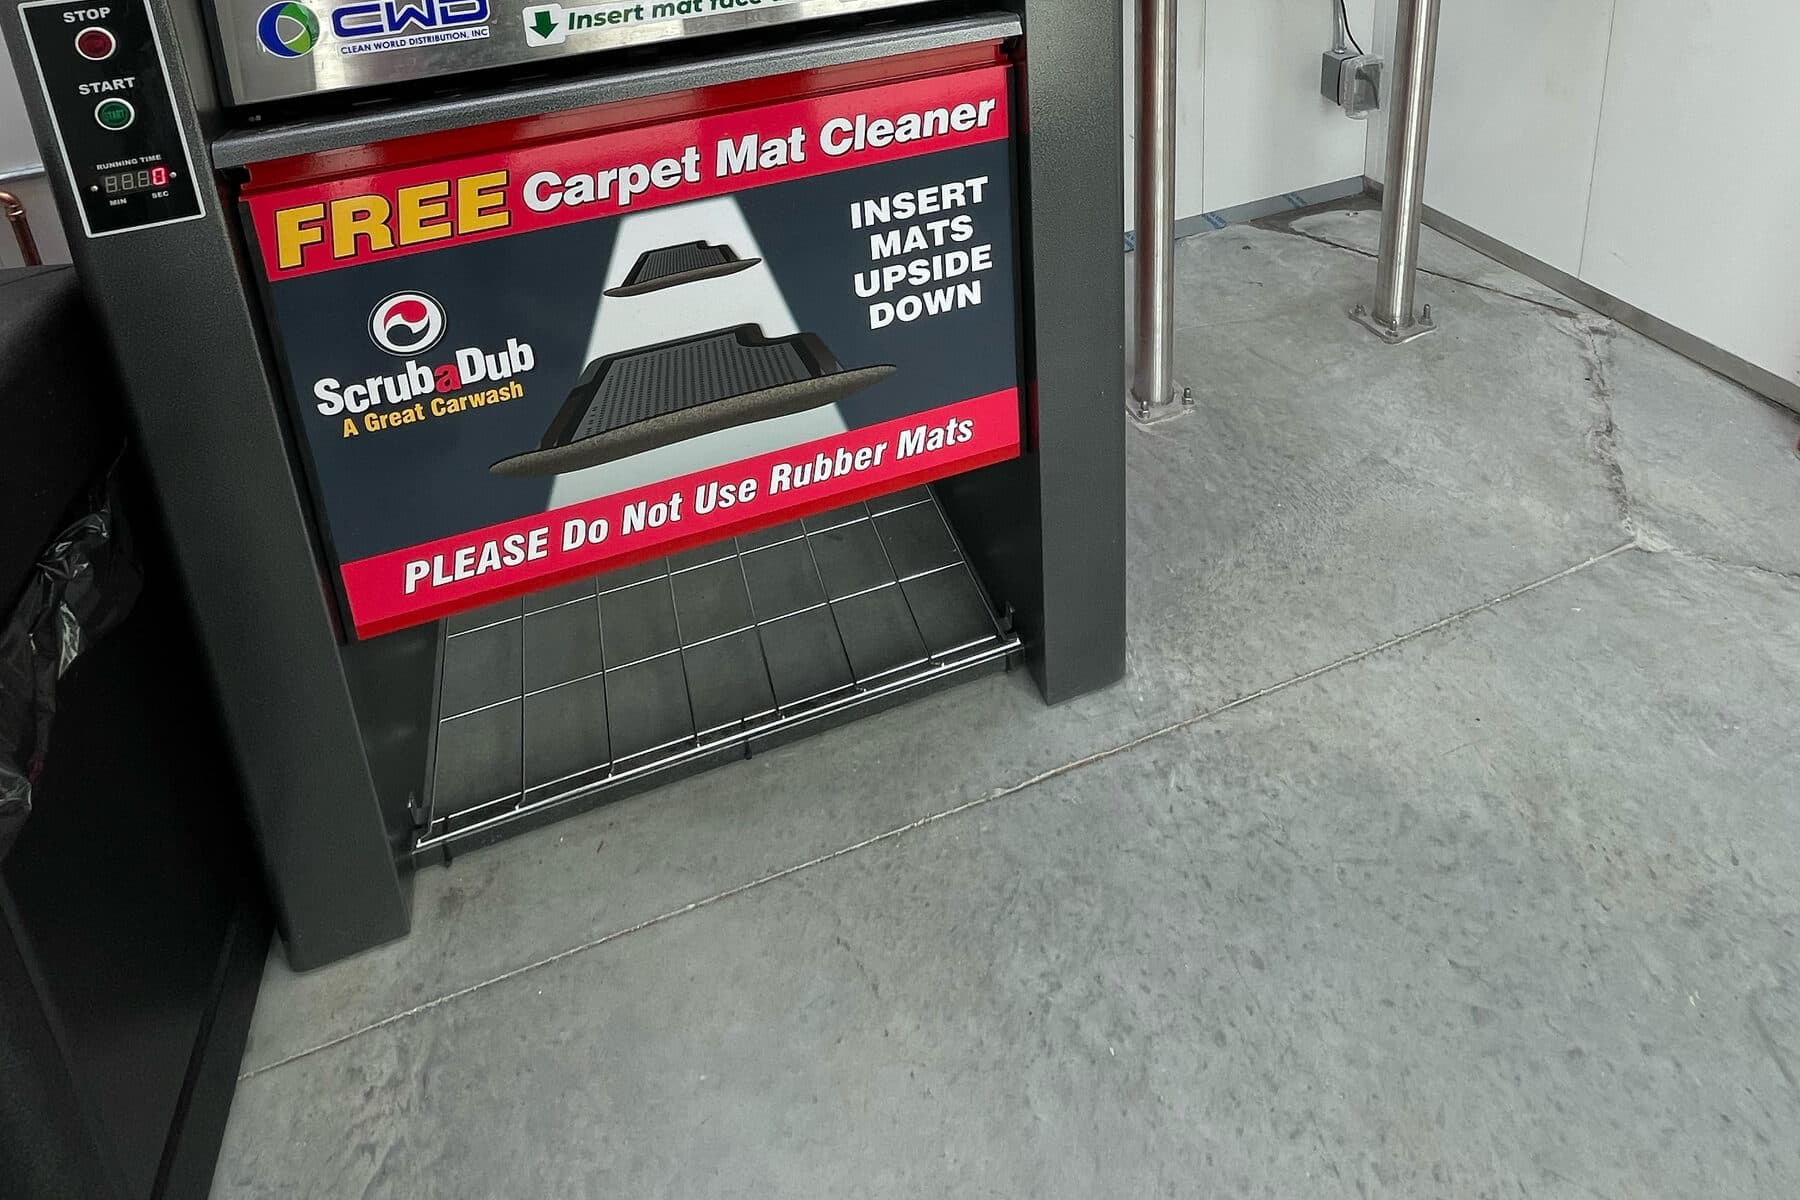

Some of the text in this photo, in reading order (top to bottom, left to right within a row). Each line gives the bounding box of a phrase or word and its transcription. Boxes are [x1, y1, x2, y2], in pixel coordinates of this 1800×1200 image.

[63, 7, 111, 23] STOP
[568, 5, 643, 31] Insert
[341, 44, 371, 55] CLEAN
[374, 38, 406, 51] WORLD
[471, 28, 488, 37] INC
[79, 77, 135, 95] START
[104, 110, 126, 120] START
[96, 154, 162, 170] RUNNING TIME
[109, 198, 127, 206] MIN
[152, 191, 169, 199] SEC
[275, 98, 996, 270] FREE Carpet Mat Cleaner
[850, 176, 988, 229] INSERT
[870, 215, 973, 261] MATS
[854, 244, 993, 298] UPSIDE
[869, 280, 982, 330] DOWN
[313, 337, 536, 417] ScrubaDub
[342, 380, 524, 438] A Great Carwash
[403, 414, 974, 595] PLEASE Do Not Use Rubber Mats
